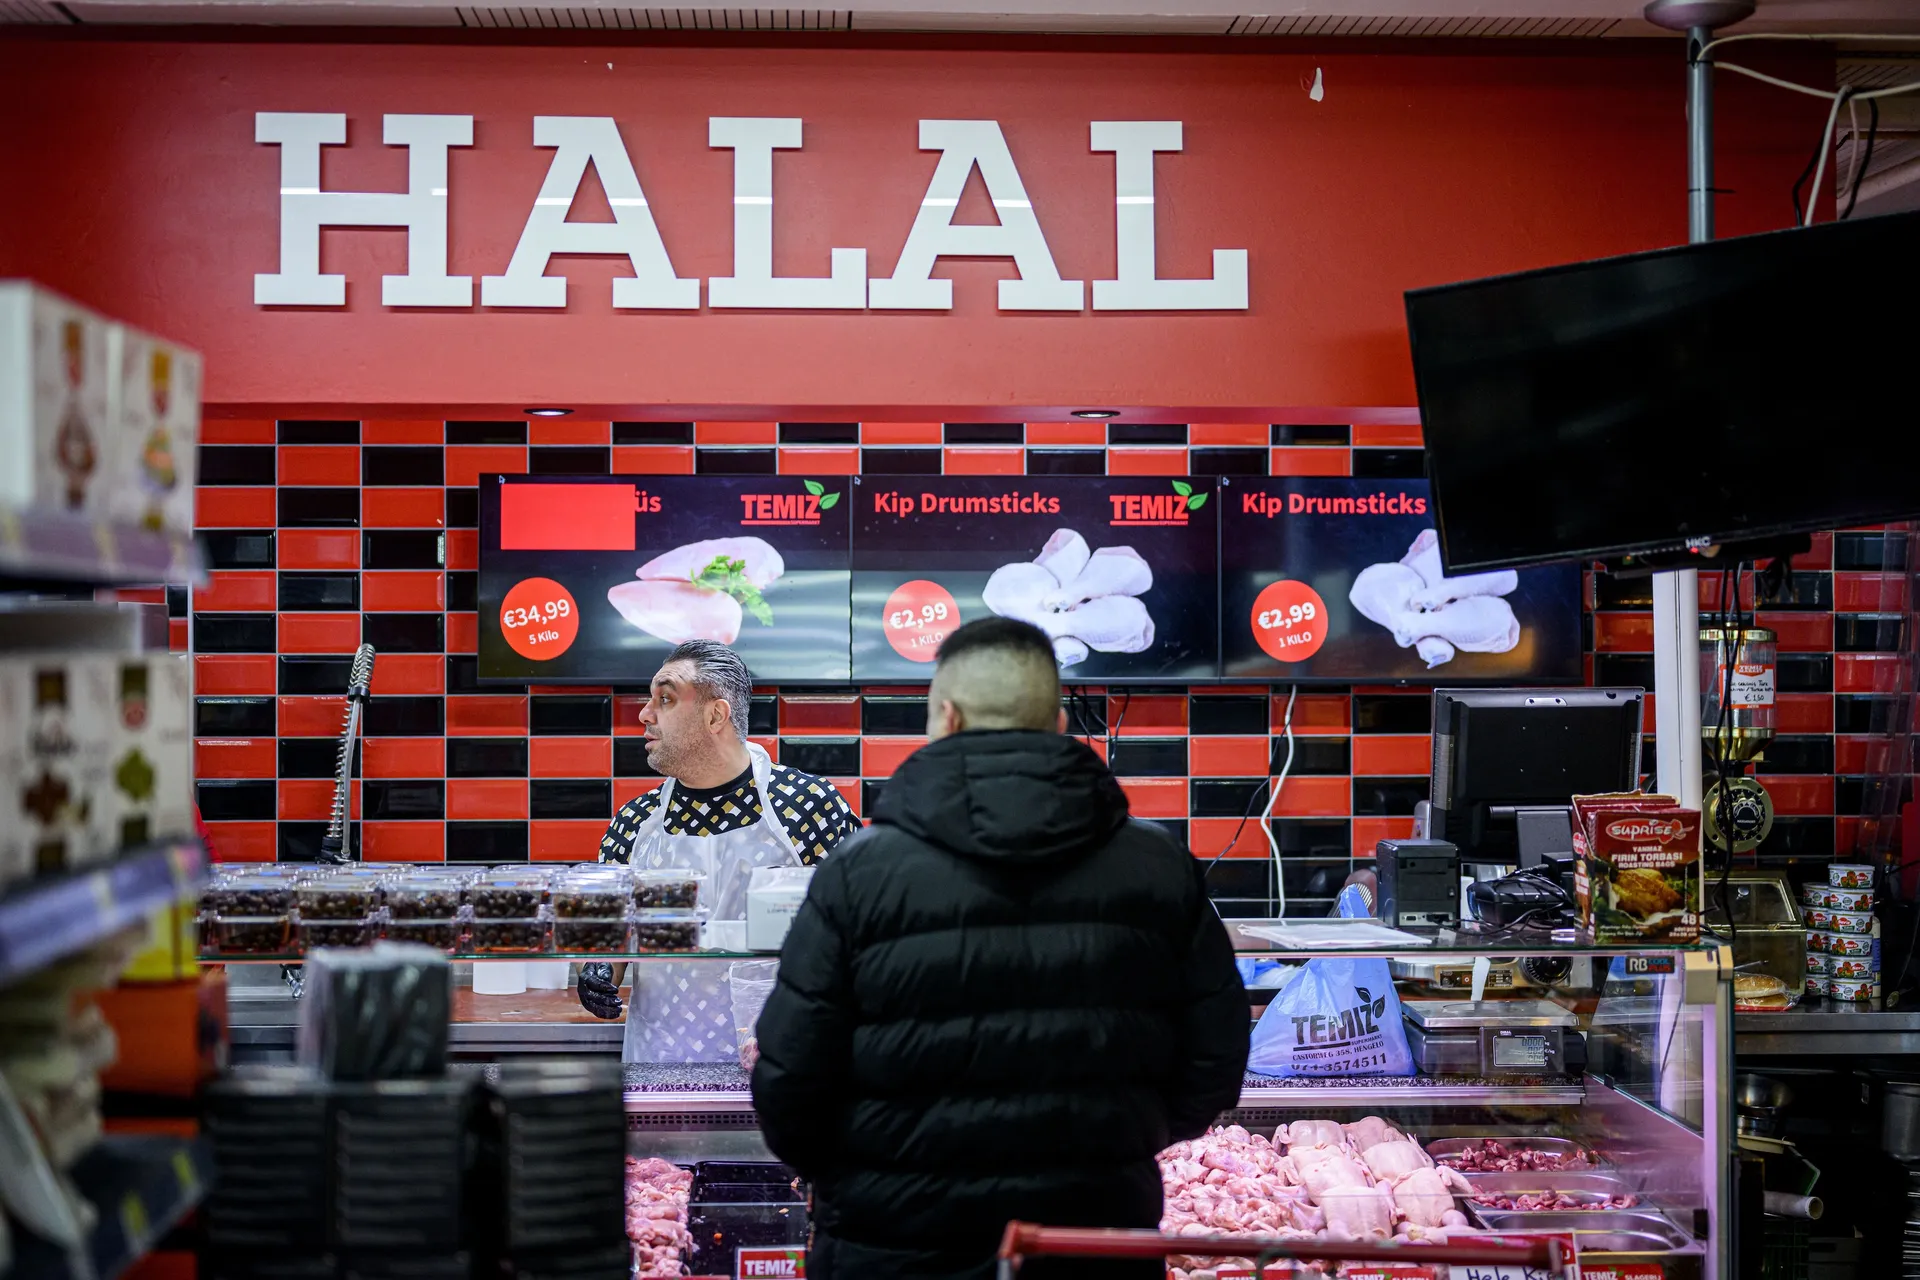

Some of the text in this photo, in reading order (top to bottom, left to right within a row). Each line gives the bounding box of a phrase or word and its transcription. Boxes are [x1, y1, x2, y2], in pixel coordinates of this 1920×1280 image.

[254, 112, 1249, 310] HALAL
[740, 494, 821, 519] TEMIZ
[874, 491, 1061, 518] Kip Drumsticks
[1109, 495, 1189, 520] TEMIZ
[1242, 491, 1427, 519] Kip Drumsticks
[503, 598, 571, 629] €34,99
[889, 601, 948, 630] €2,99
[1257, 601, 1317, 630] €2,99
[528, 629, 560, 645] 5 Kilo
[910, 631, 945, 648] 1 KILO
[1278, 630, 1313, 648] 1 KILO
[1611, 852, 1683, 862] FIRIN TORBASI
[1681, 913, 1697, 925] 48
[1629, 957, 1648, 972] RB
[1291, 1003, 1380, 1045] TEMIZ
[1353, 1040, 1384, 1053] HENGELO
[743, 1259, 797, 1276] TEMIZ
[1583, 1271, 1618, 1280] TEMIZ
